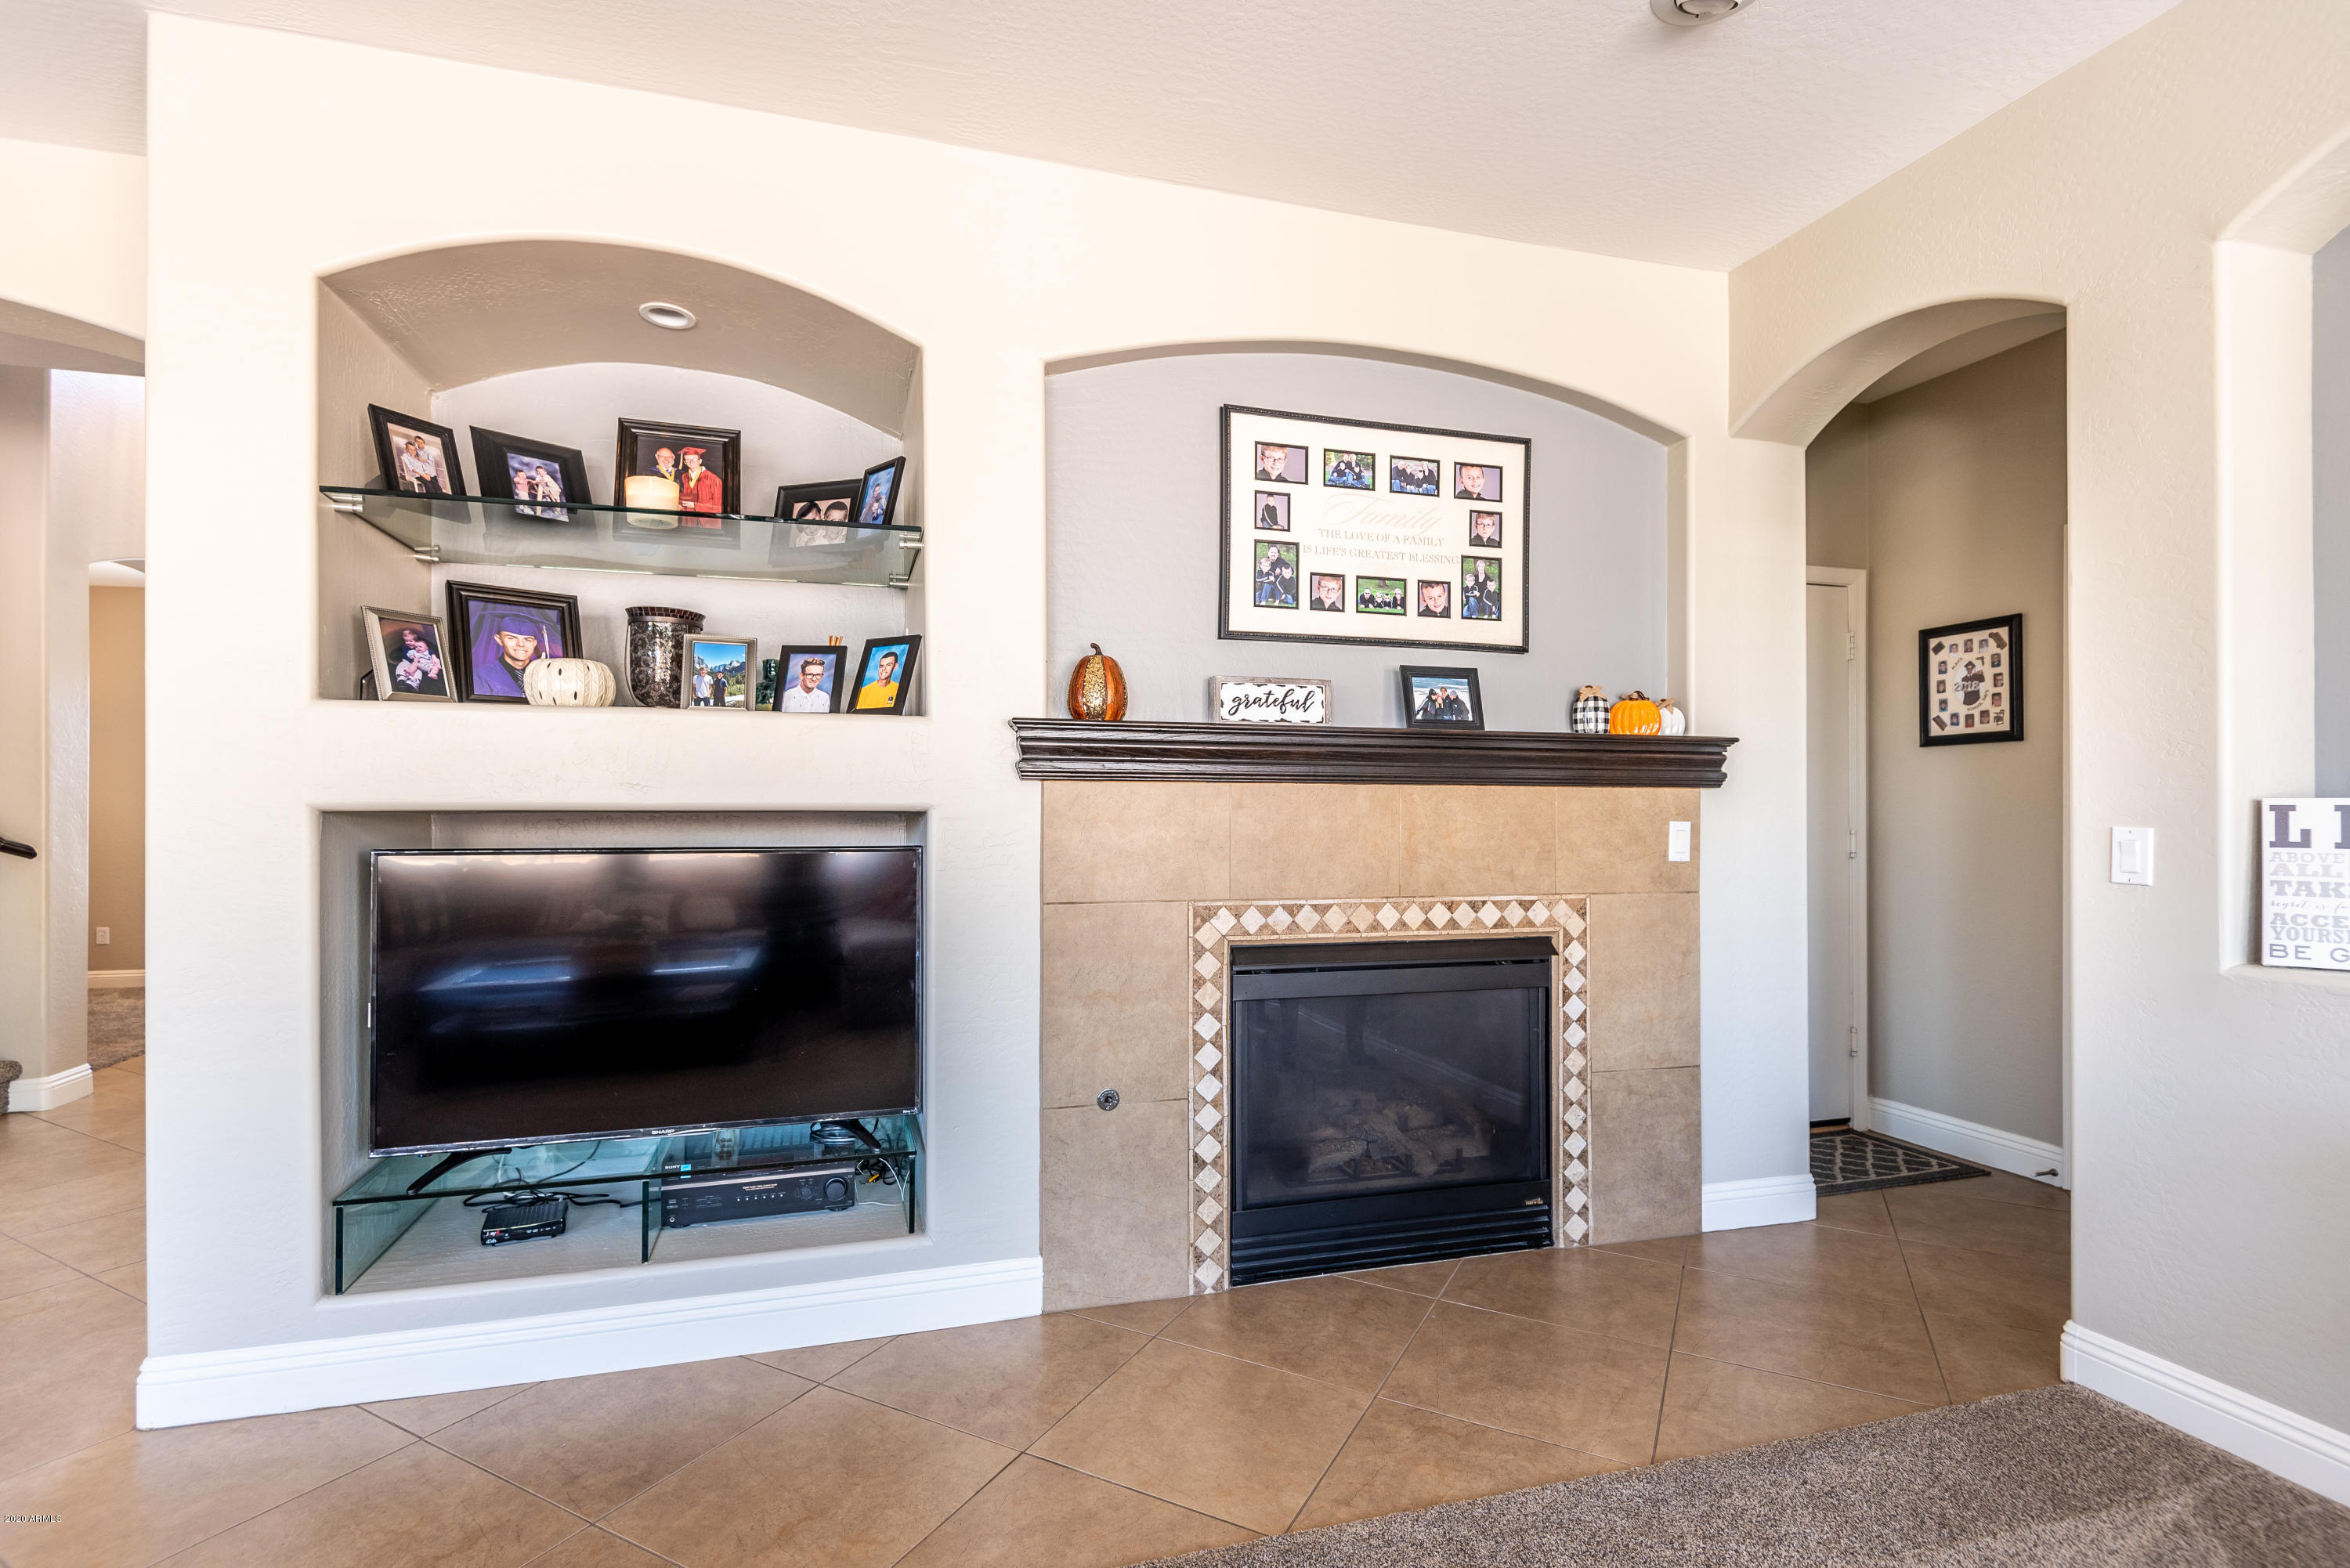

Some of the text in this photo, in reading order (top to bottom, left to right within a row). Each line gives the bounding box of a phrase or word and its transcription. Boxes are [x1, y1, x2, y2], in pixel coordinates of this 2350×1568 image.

[1323, 493, 1442, 537] Family
[1318, 528, 1445, 547] THE LOVE OF A FAMILY
[1303, 544, 1459, 565] IS LIFE'S GREATEST BLESSING
[1228, 688, 1315, 716] grateful
[2269, 851, 2345, 864] ABOVE
[2269, 863, 2345, 878] ALL
[2269, 880, 2350, 899] TAK
[2269, 943, 2350, 963] BE G
